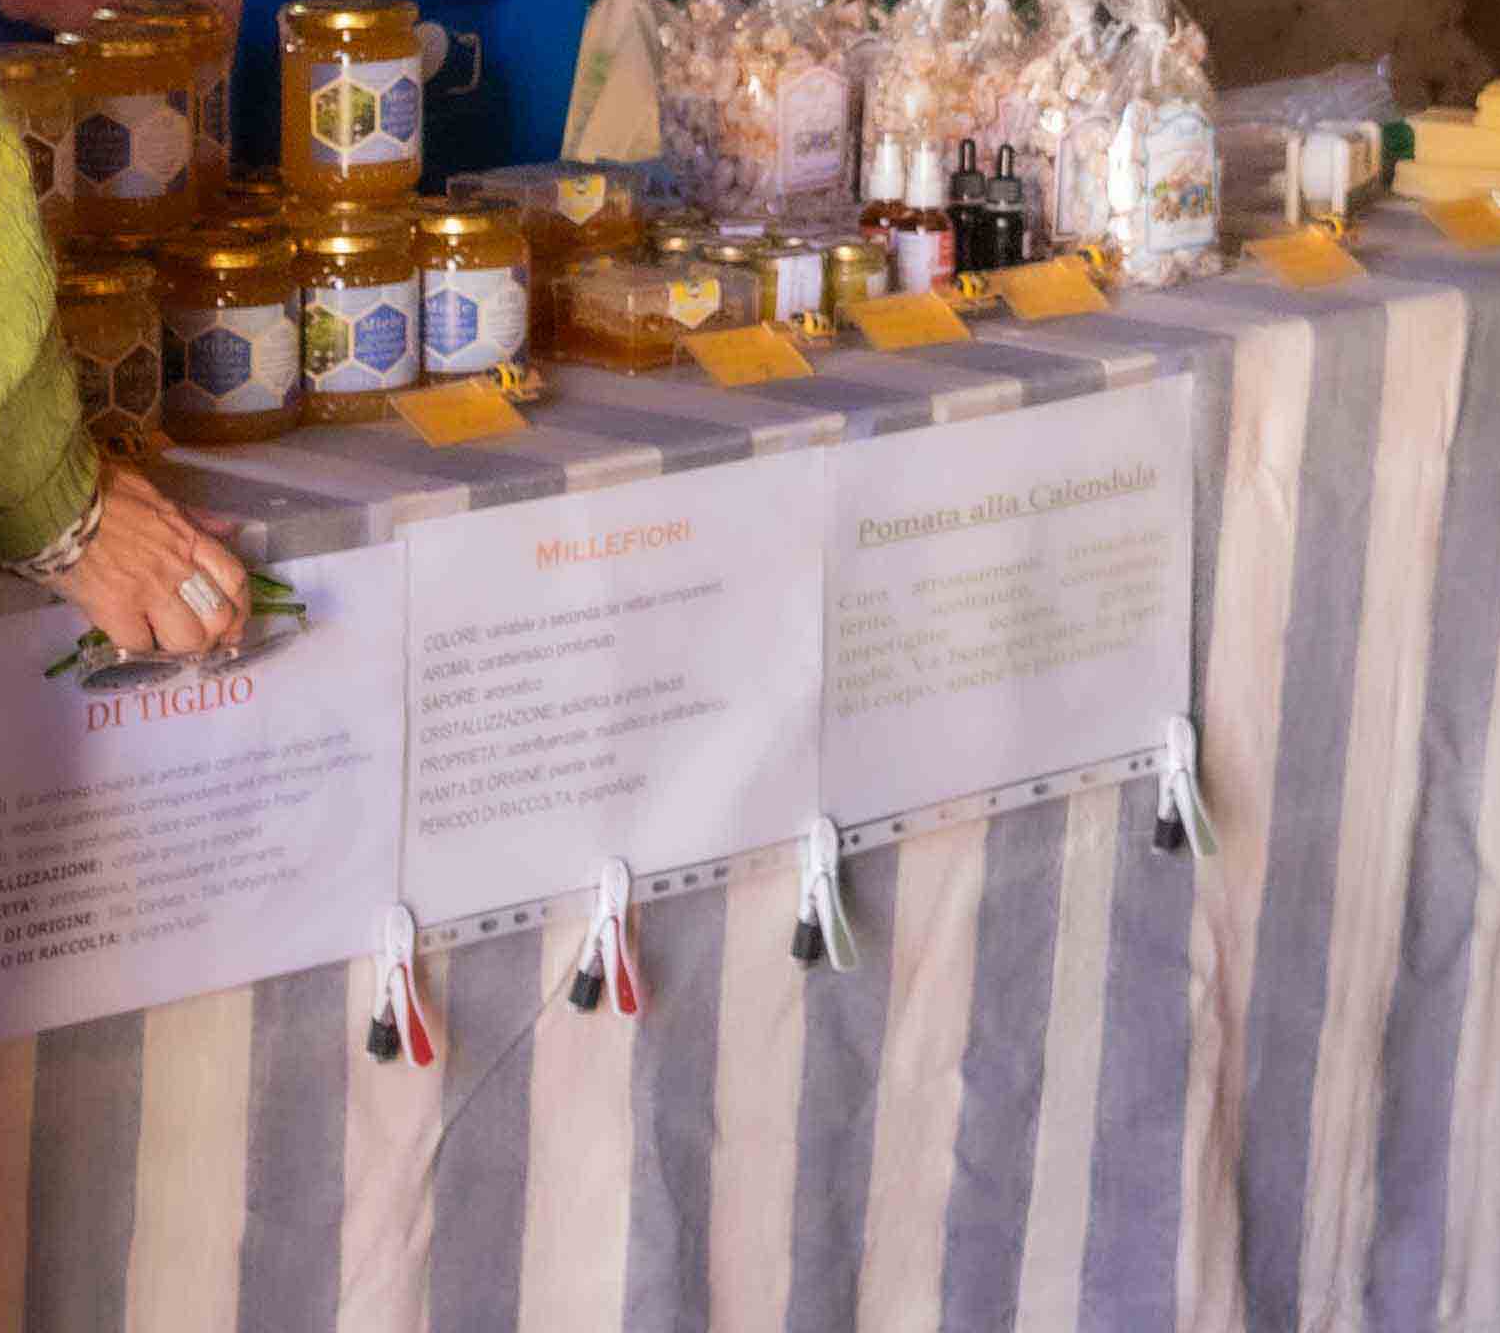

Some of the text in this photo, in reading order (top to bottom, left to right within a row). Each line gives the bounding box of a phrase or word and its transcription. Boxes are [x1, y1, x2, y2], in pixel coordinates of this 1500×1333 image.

[857, 462, 1158, 545] Pomata alla Calendula
[536, 518, 690, 571] MILLEFIORI
[87, 677, 254, 731] DI TIGLIO
